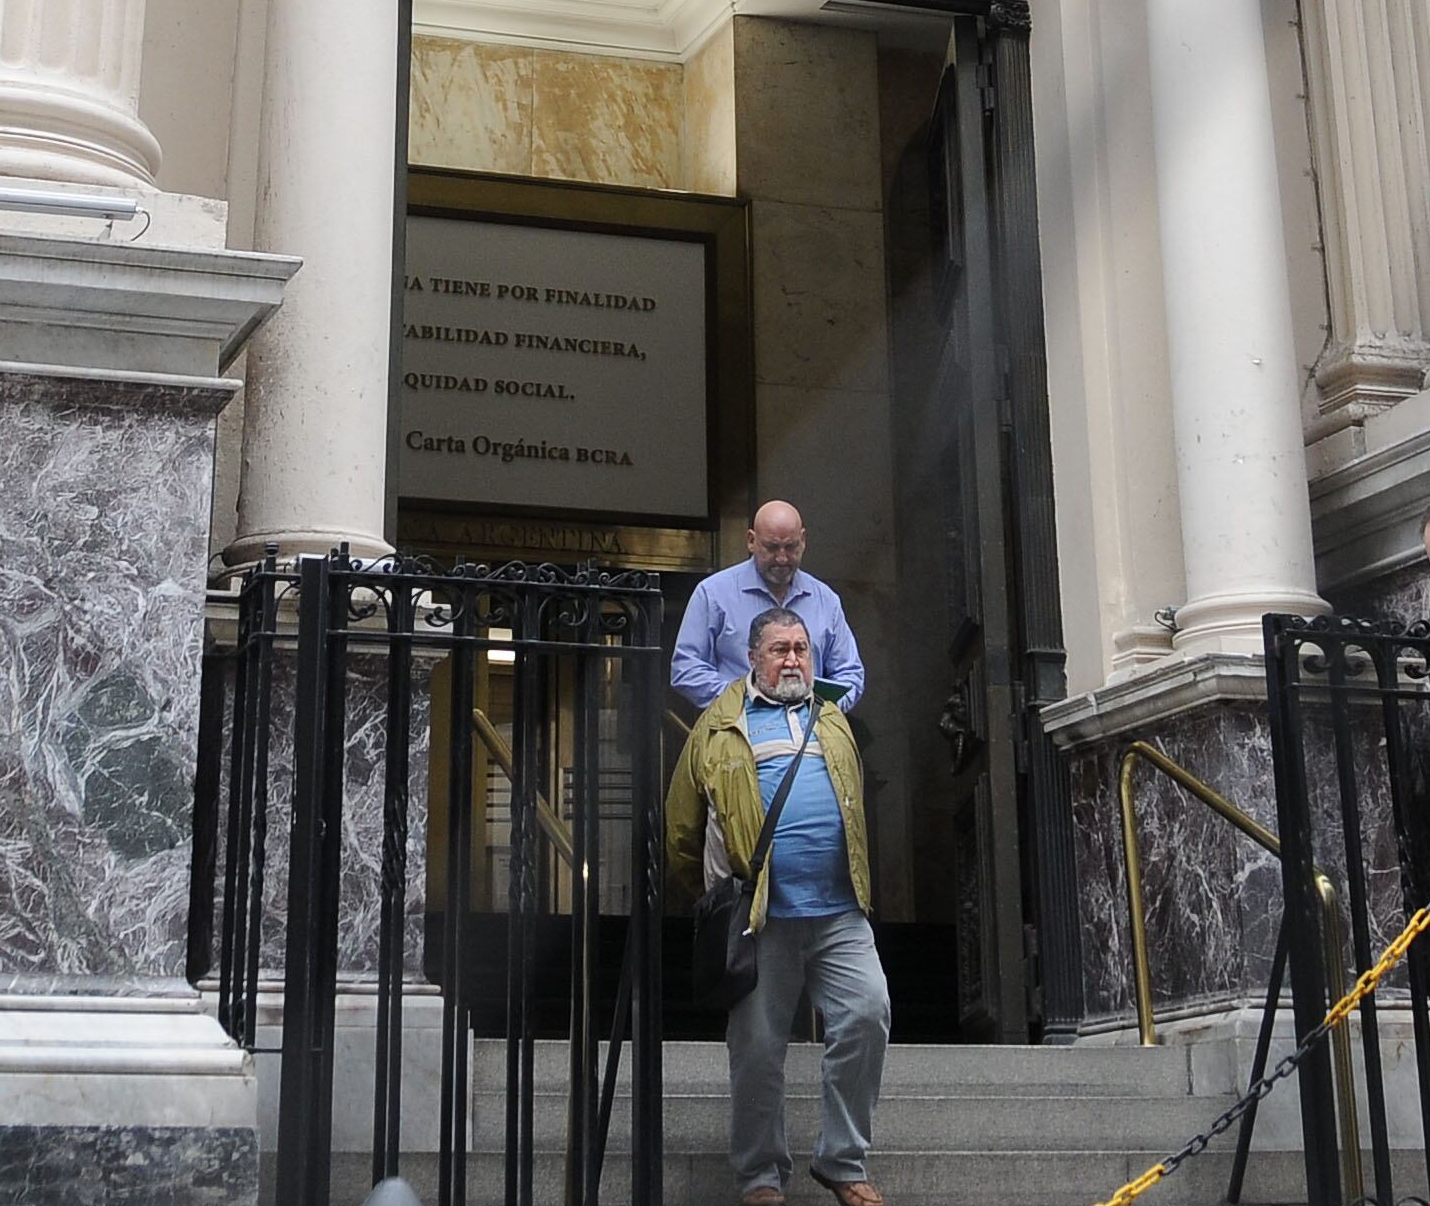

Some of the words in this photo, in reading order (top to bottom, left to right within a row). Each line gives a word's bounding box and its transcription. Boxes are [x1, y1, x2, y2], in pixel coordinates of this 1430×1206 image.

[430, 278, 491, 297] TIENE
[497, 284, 539, 301] POR
[545, 289, 656, 312] FINALIDAD
[402, 323, 509, 346] ABILIDAD
[515, 334, 647, 361] FINANCIERA,
[494, 379, 575, 400] SOCIAL.
[405, 430, 466, 454] Carta
[472, 435, 570, 463] Orgánica
[576, 448, 633, 466] BCRA
